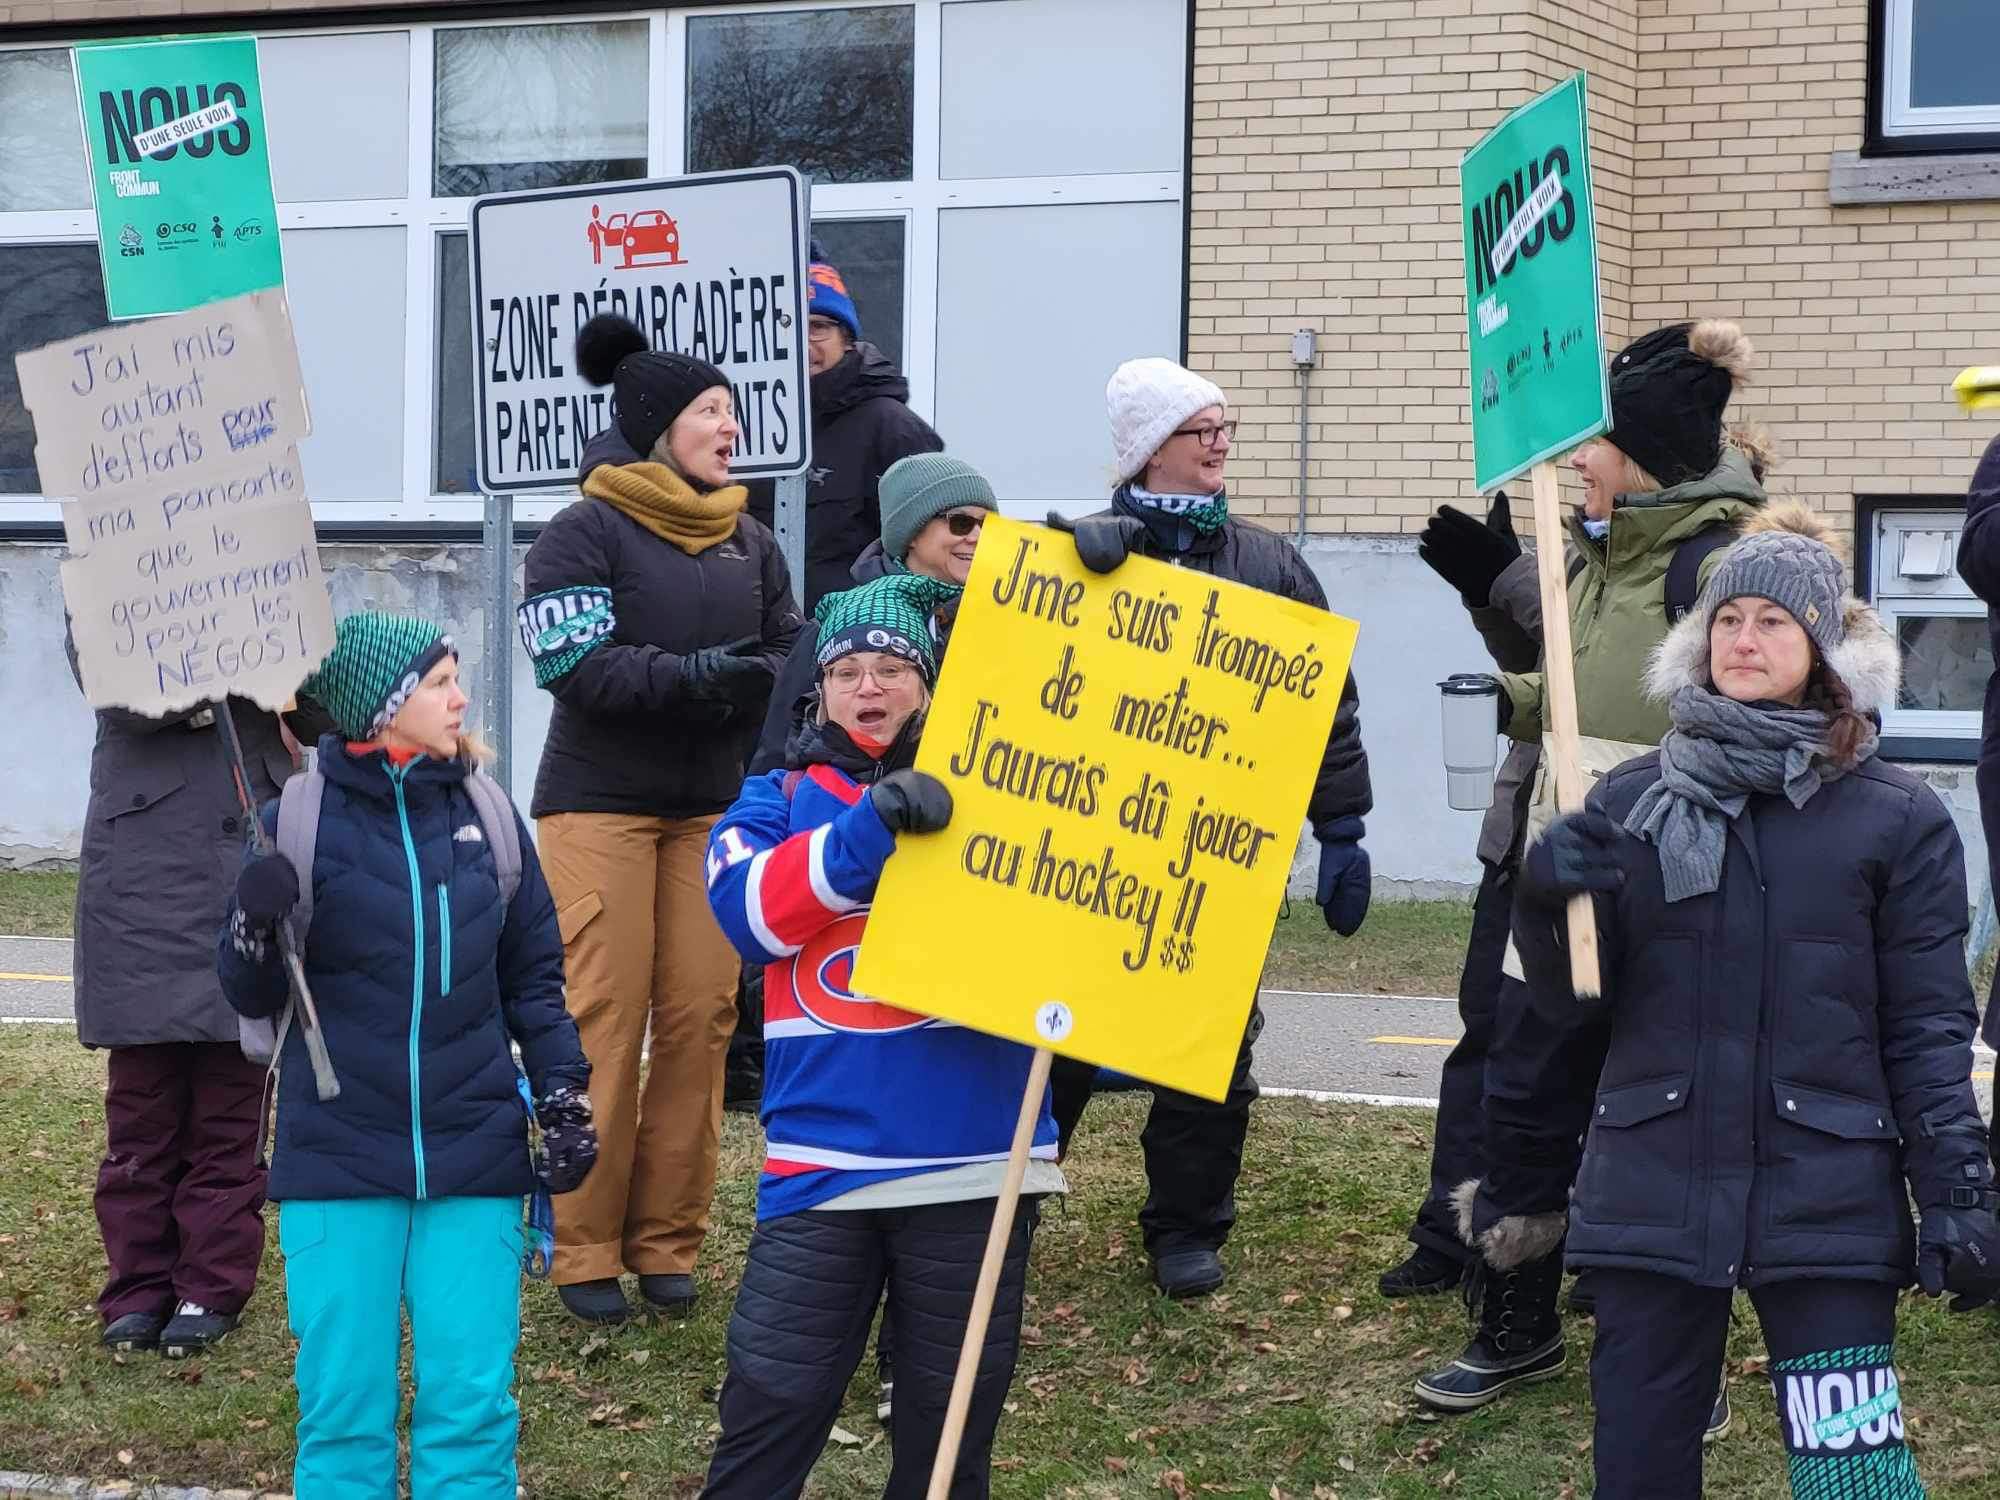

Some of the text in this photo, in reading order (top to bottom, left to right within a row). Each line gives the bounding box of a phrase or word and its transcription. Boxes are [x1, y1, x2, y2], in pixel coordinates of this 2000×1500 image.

[100, 82, 251, 164] NOUS
[139, 104, 232, 152] D'UNE SEULE VOIX
[109, 169, 140, 185] FRONT
[116, 181, 160, 197] COMMUN
[120, 246, 145, 257] CSN
[173, 222, 197, 233] CSQ
[1472, 145, 1576, 295] NOUS
[71, 322, 235, 396] J'ai mis
[490, 293, 564, 382] ZONE
[101, 368, 205, 432] autant
[496, 393, 616, 474] PARENT
[82, 422, 203, 492] d'efforts
[88, 461, 295, 541] ma pancarte
[137, 523, 241, 585] que le
[111, 543, 310, 658] gouvernement
[146, 592, 291, 660] pour les
[1041, 643, 1086, 721] de
[1107, 589, 1182, 654] suis
[1193, 589, 1324, 713] trompée
[950, 700, 1277, 880] J'aurais dû jouer
[960, 831, 1024, 888] au
[1159, 935, 1197, 975] $$
